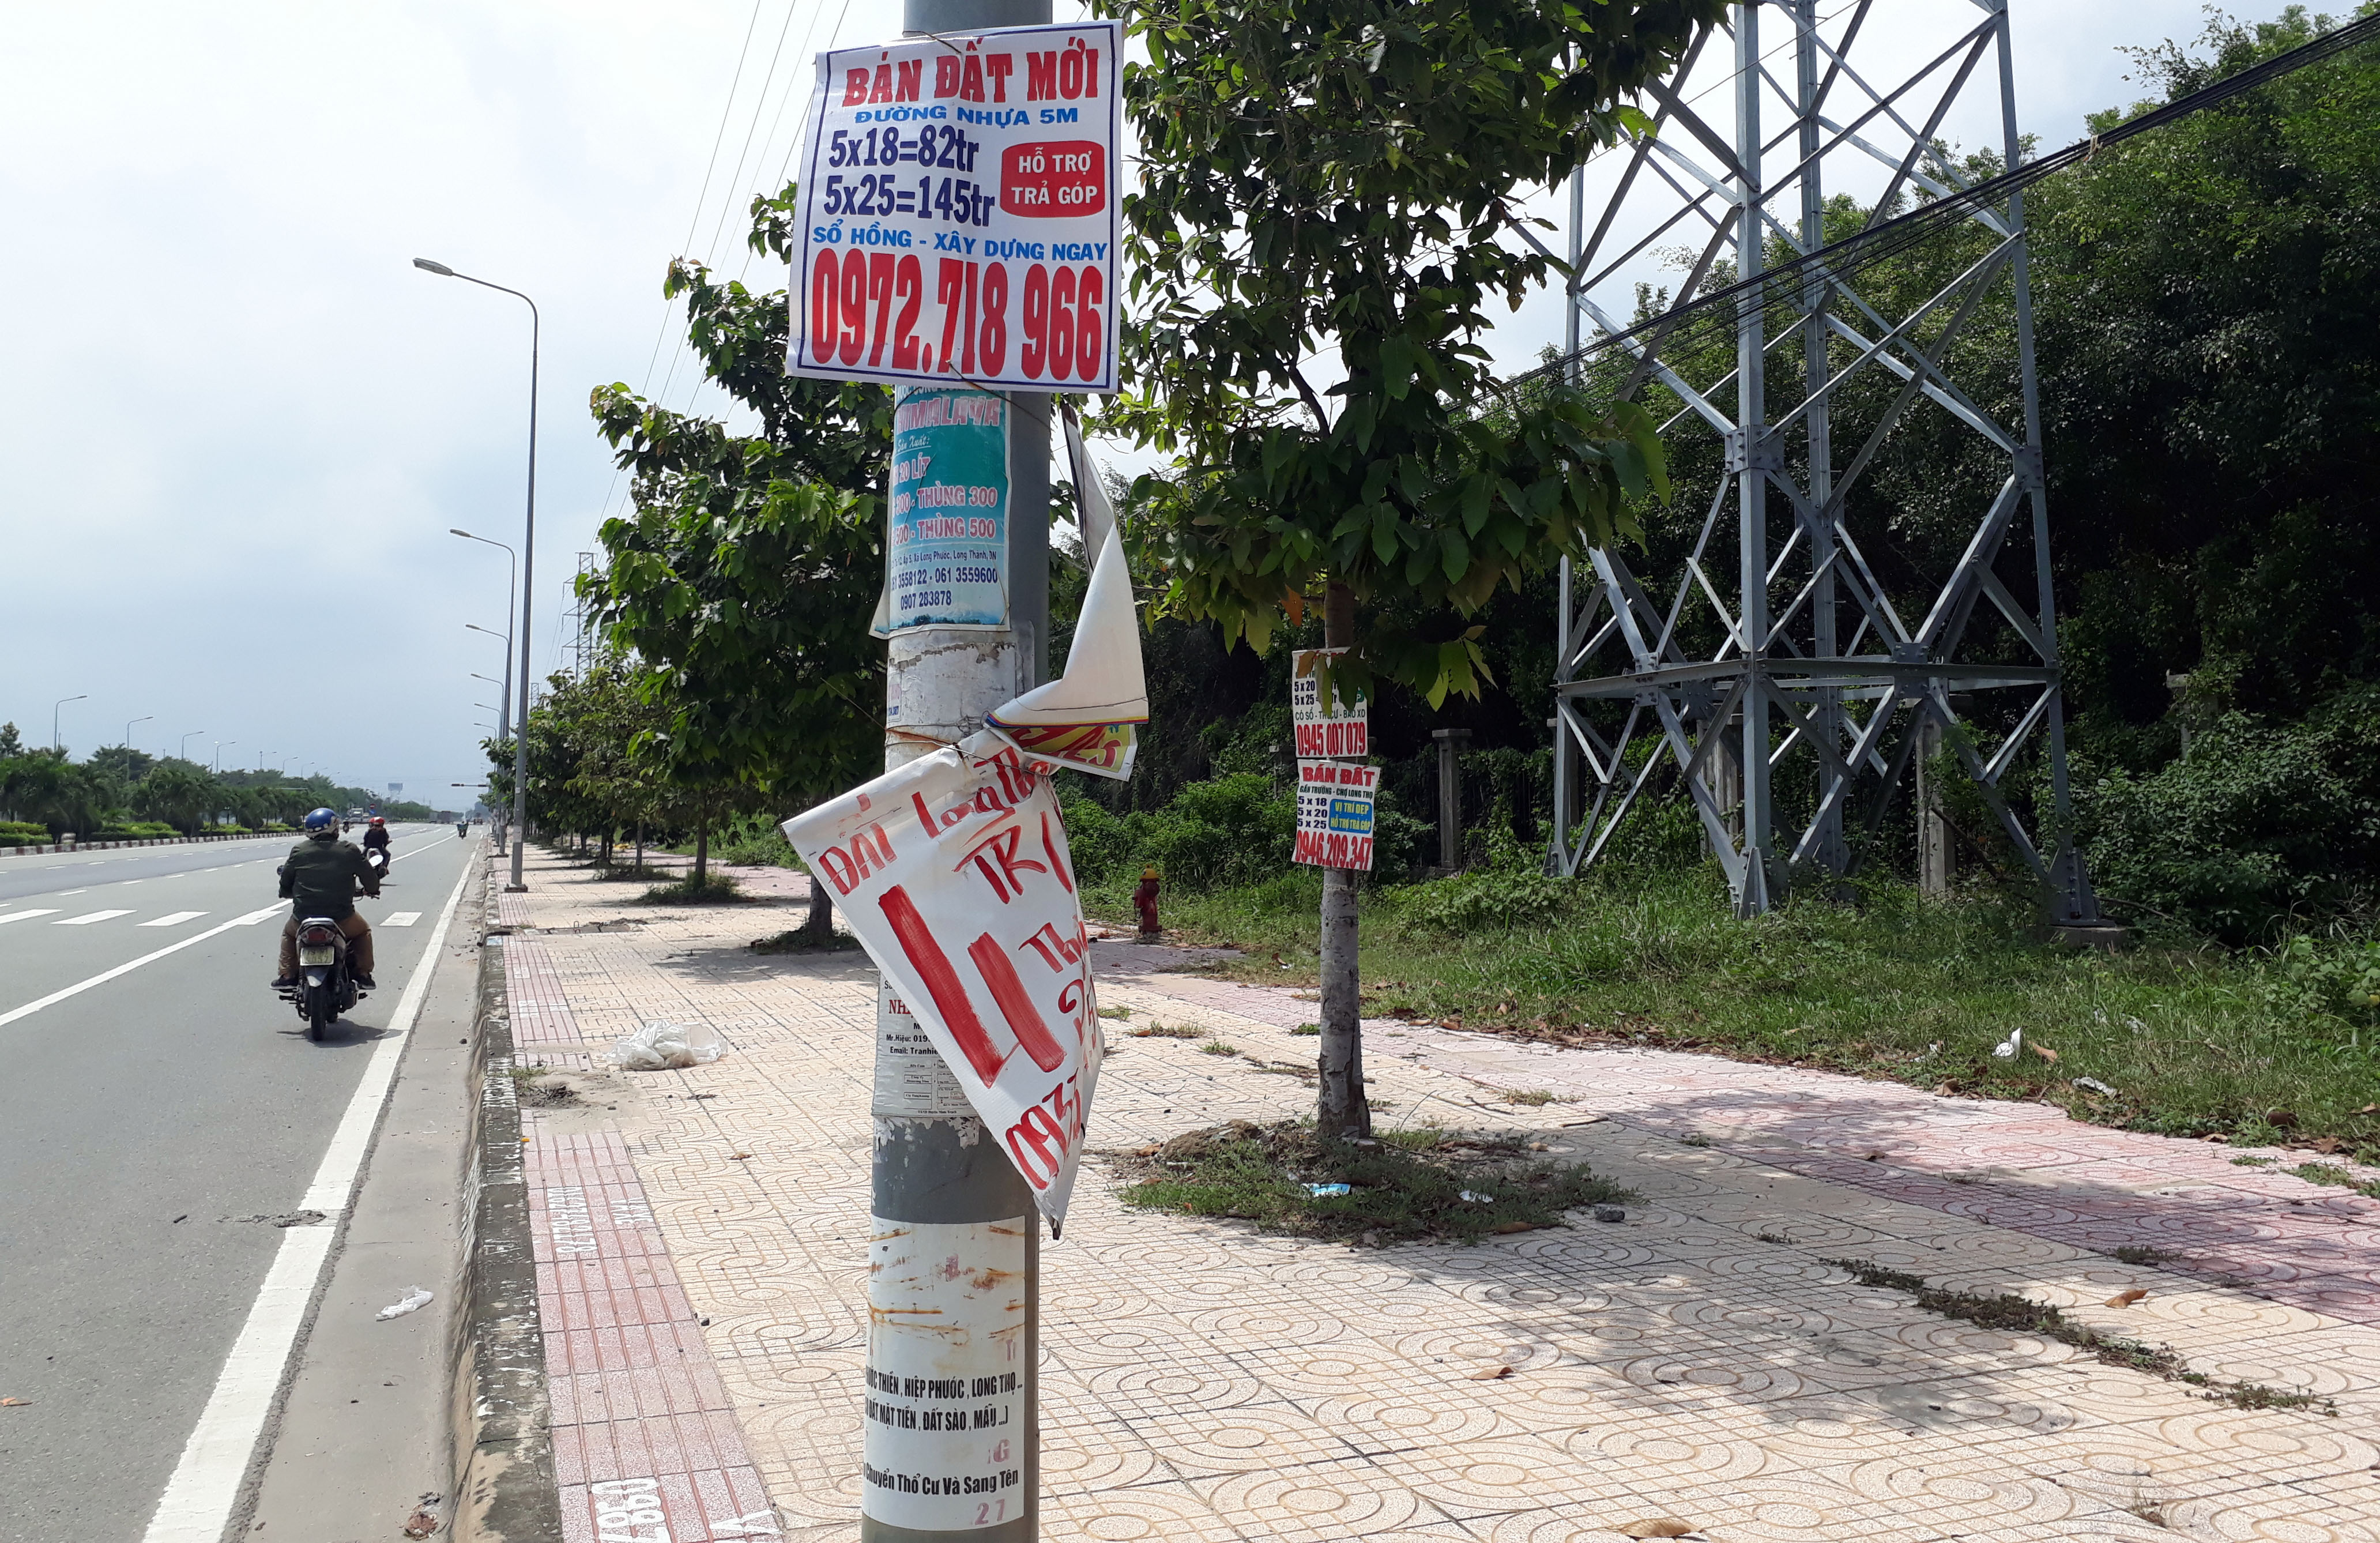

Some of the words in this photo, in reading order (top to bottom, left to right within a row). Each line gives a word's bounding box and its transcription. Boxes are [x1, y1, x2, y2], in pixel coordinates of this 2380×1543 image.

[842, 51, 922, 107] BÁN
[933, 36, 1012, 104] ĐẤT
[1026, 36, 1099, 101] MỚI
[854, 105, 947, 123] ĐƯỜNG
[958, 106, 1031, 129] NHỰA
[1039, 107, 1079, 123] 5M
[829, 124, 980, 172] 5x18=82tr
[1018, 148, 1045, 174] HỖ
[1051, 150, 1093, 176] TRỢ
[823, 174, 996, 227] 5x25=145tr
[1011, 180, 1050, 205] TRẢ
[1057, 181, 1097, 205] GÓP
[813, 218, 844, 244] SỔ
[851, 220, 913, 248] HỒNG
[933, 229, 978, 255] XÂY
[984, 238, 1046, 262] DỰNG
[1051, 243, 1109, 261] NGAY
[1021, 263, 1104, 383] 966
[899, 461, 910, 484] 20
[912, 452, 931, 480] LÍT
[895, 491, 911, 515] 300
[917, 481, 966, 509] THÙNG
[969, 486, 998, 508] 300
[917, 513, 966, 541] THÙNG
[969, 518, 996, 539] 500
[920, 552, 932, 563] Long
[953, 550, 967, 561] Long
[935, 567, 951, 584] 061
[955, 567, 998, 584] 3559600
[901, 593, 917, 611] 0907
[918, 590, 952, 608] 283878
[1306, 680, 1315, 691] 20
[1306, 694, 1315, 705] 25
[1295, 709, 1304, 721] CÓ
[1297, 724, 1324, 756] 0945
[1326, 722, 1344, 755] 007
[1346, 721, 1366, 755] 079
[1302, 763, 1336, 783] BÁN
[1340, 766, 1374, 786] ĐẤT
[1298, 796, 1304, 804] 5
[1315, 797, 1327, 807] 18
[1298, 807, 1304, 816] 5
[1314, 809, 1328, 818] 20
[1297, 818, 1304, 827] 5
[1313, 819, 1327, 829] 25
[890, 1046, 909, 1055] Email:
[905, 1375, 926, 1403] HIỆP
[928, 1376, 965, 1399] PHƯỚC
[971, 1376, 997, 1398] LONG
[999, 1371, 1016, 1395] THỌ
[879, 1402, 895, 1430] MẶT
[897, 1405, 917, 1430] TIỀN
[923, 1407, 943, 1431] ĐẤT
[945, 1407, 967, 1431] SÀO
[897, 1473, 921, 1494] Thổ
[922, 1477, 940, 1495] Cư
[943, 1476, 961, 1495] Và
[963, 1475, 997, 1495] Sang
[999, 1469, 1019, 1489] Tên
